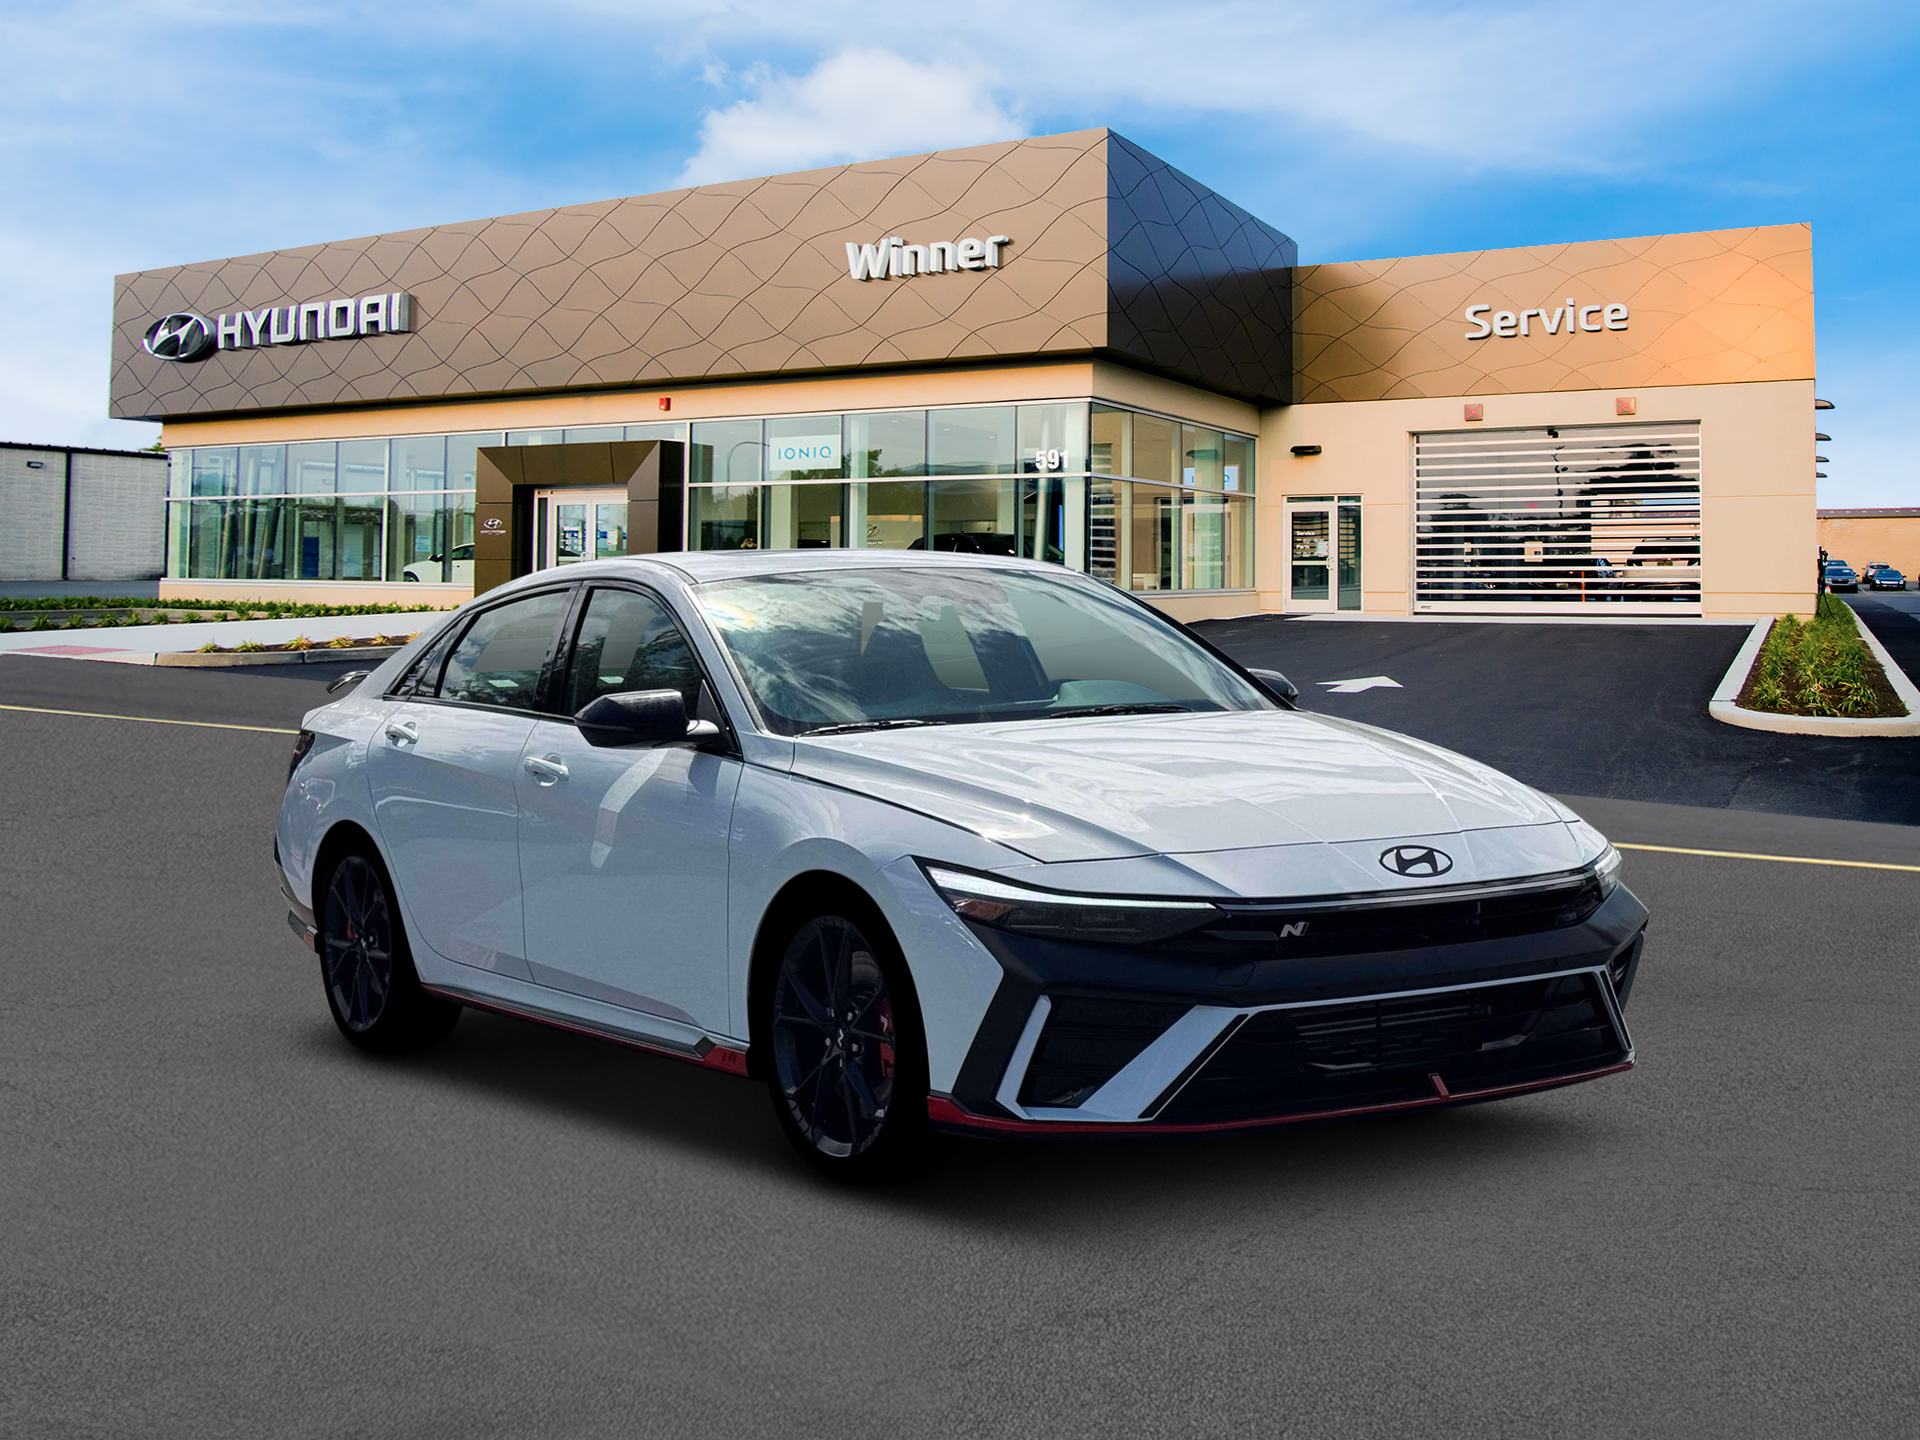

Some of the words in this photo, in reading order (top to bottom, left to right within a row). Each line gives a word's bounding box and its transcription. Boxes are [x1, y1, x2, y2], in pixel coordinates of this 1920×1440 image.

[845, 236, 1009, 281] Winner
[217, 292, 409, 350] HYUNDAI
[1465, 297, 1629, 340] Service
[778, 446, 832, 460] IONIQ
[1035, 449, 1069, 470] 591
[1280, 921, 1309, 938] N
